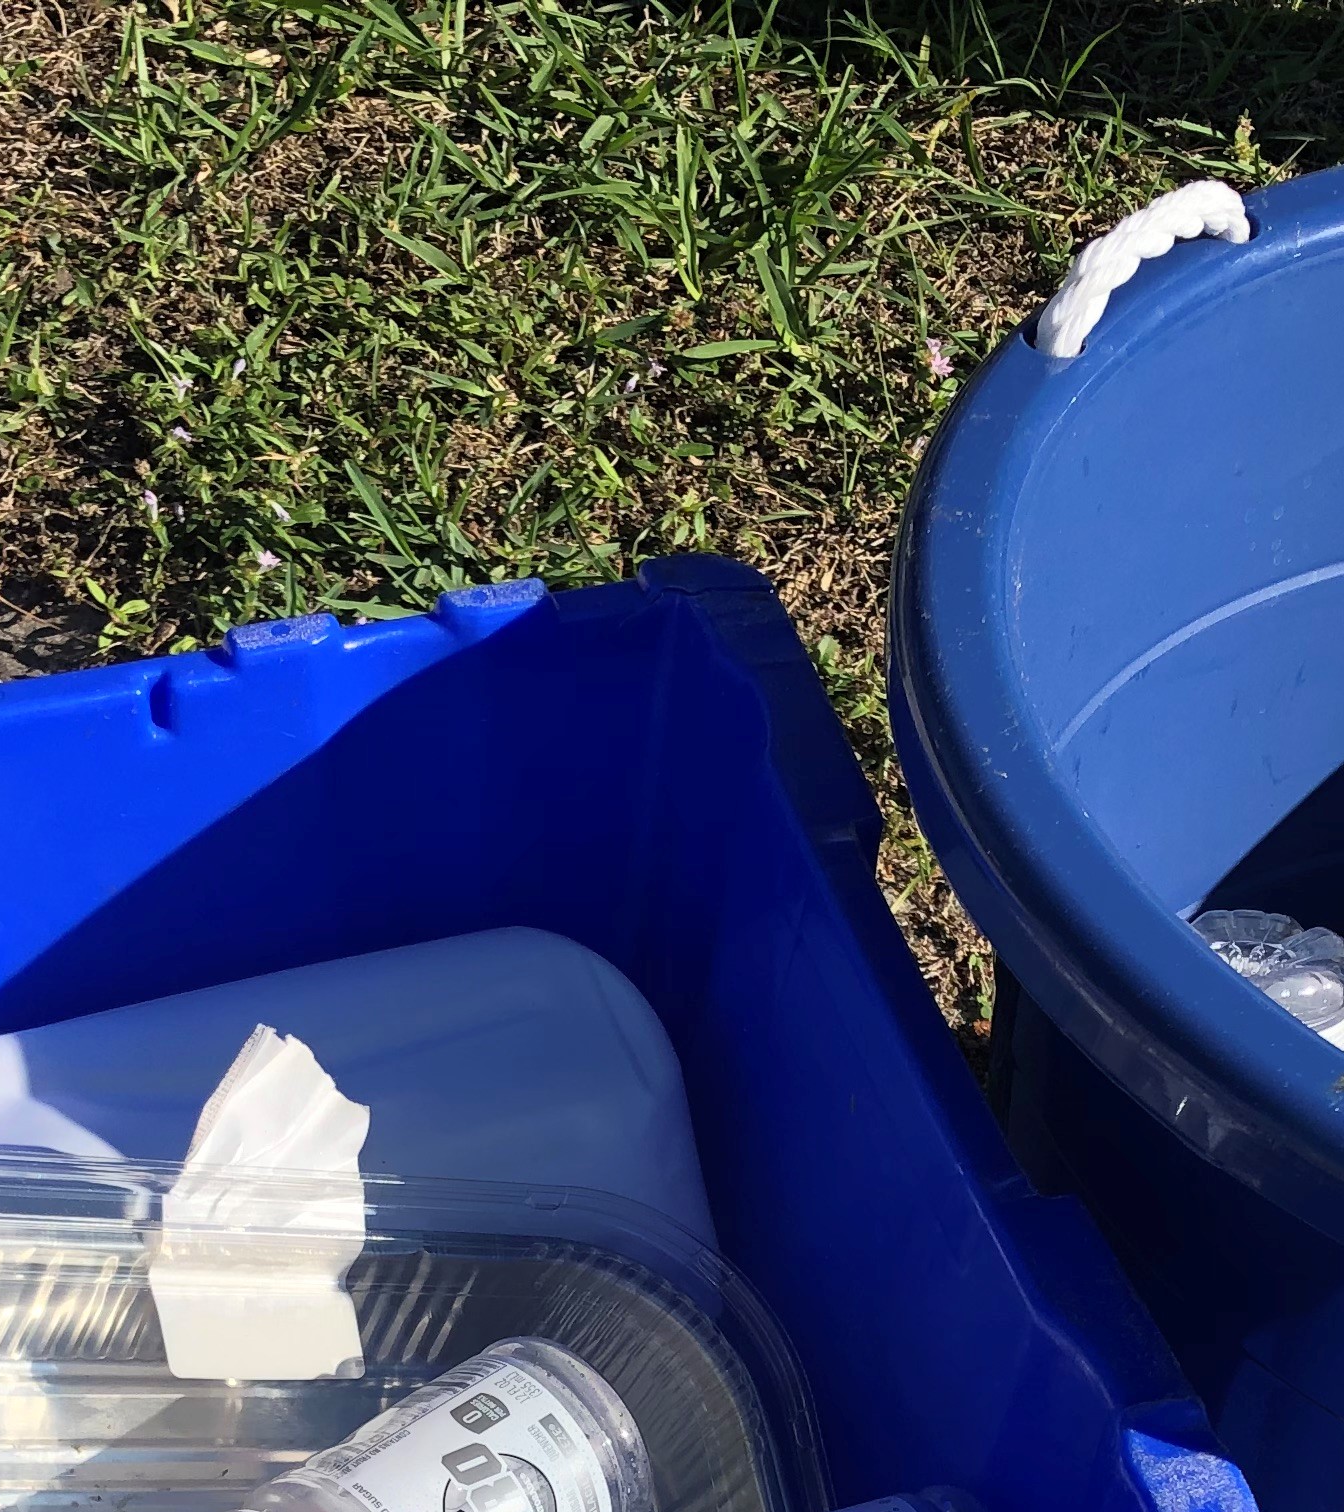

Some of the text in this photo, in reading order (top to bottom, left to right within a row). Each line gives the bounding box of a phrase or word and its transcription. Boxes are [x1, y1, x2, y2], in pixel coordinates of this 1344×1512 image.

[493, 1376, 529, 1404] 12 FL OZ
[506, 1368, 543, 1399] (355 mL)
[460, 1408, 482, 1425] 0
[470, 1396, 499, 1422] CALORIES
[478, 1392, 506, 1417] PER BOTTLE
[378, 1428, 410, 1451] CONTAINS
[526, 1423, 560, 1462] QUENCHER
[351, 1480, 382, 1509] SUGAR
